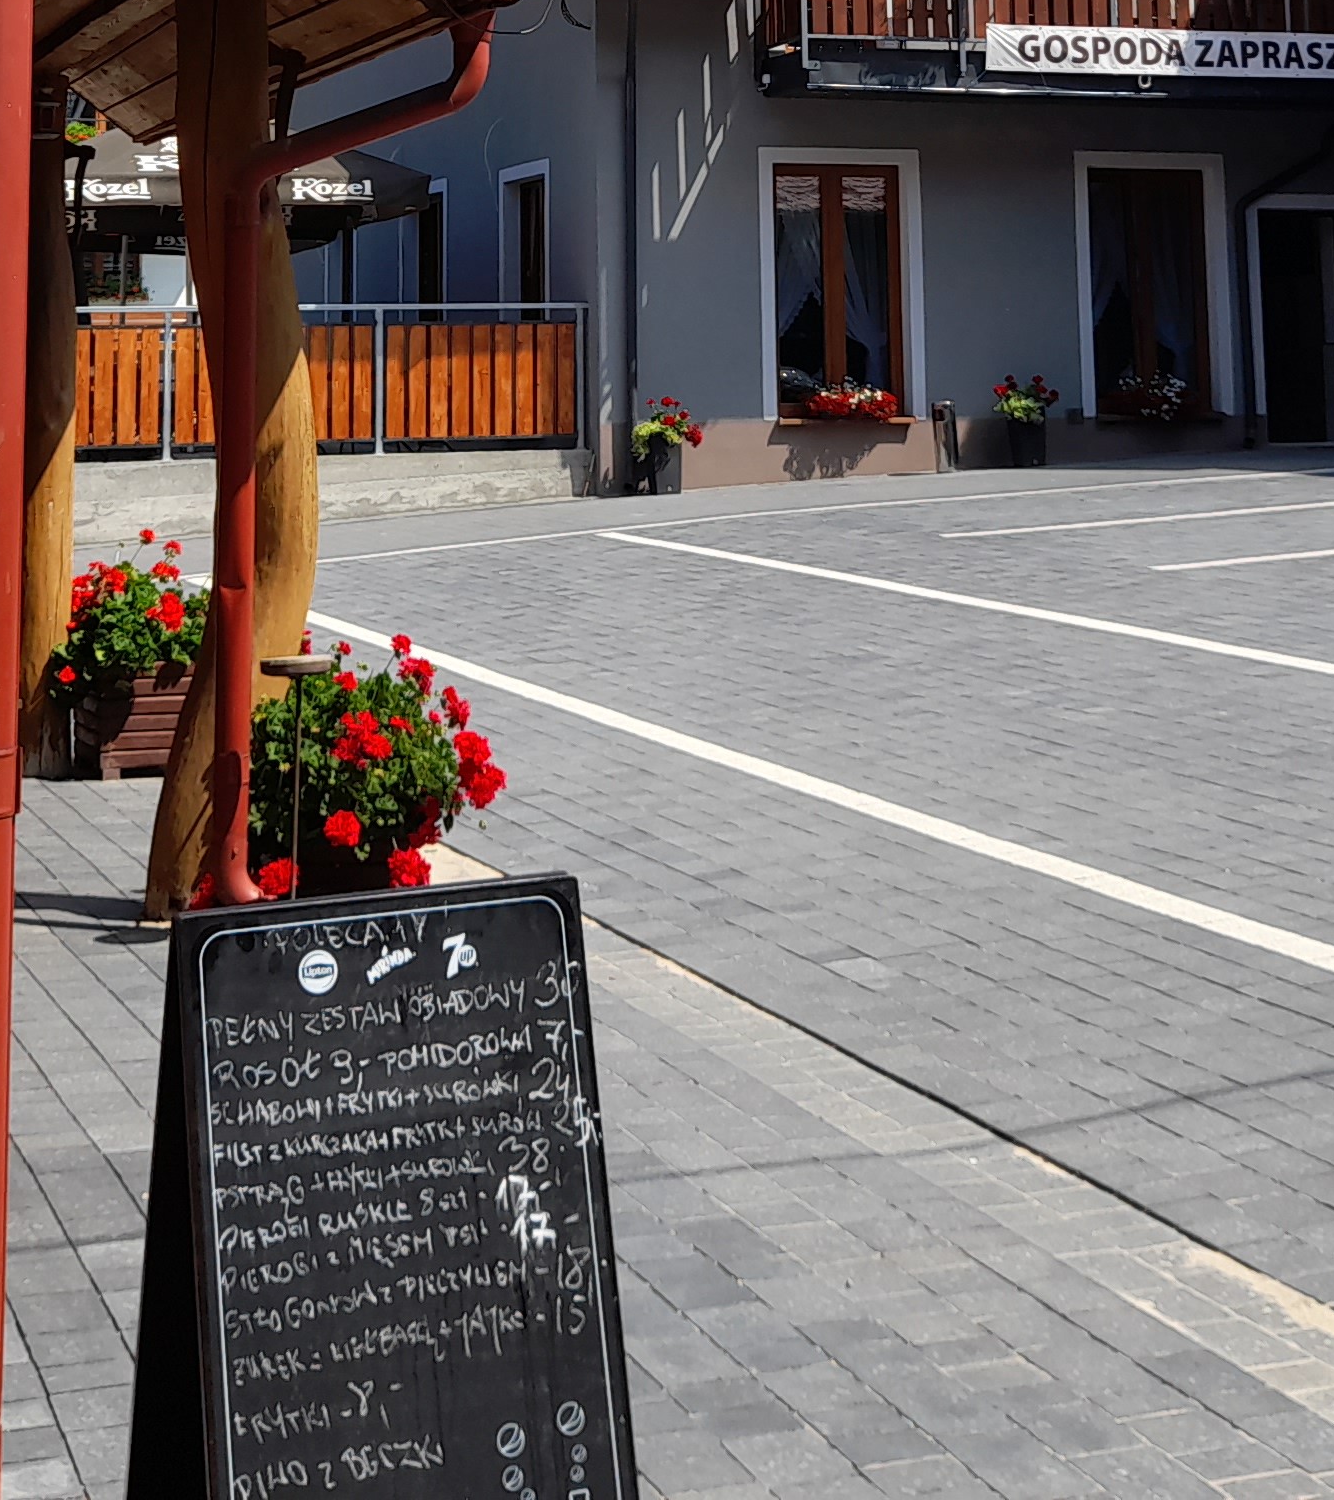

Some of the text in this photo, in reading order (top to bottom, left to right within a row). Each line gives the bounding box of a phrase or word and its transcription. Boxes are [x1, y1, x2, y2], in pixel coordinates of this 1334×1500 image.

[1018, 34, 1186, 68] GOSPODA
[292, 178, 373, 201] Kozel
[300, 999, 403, 1037] ZESTAW
[408, 978, 525, 1023] OBIADOWY
